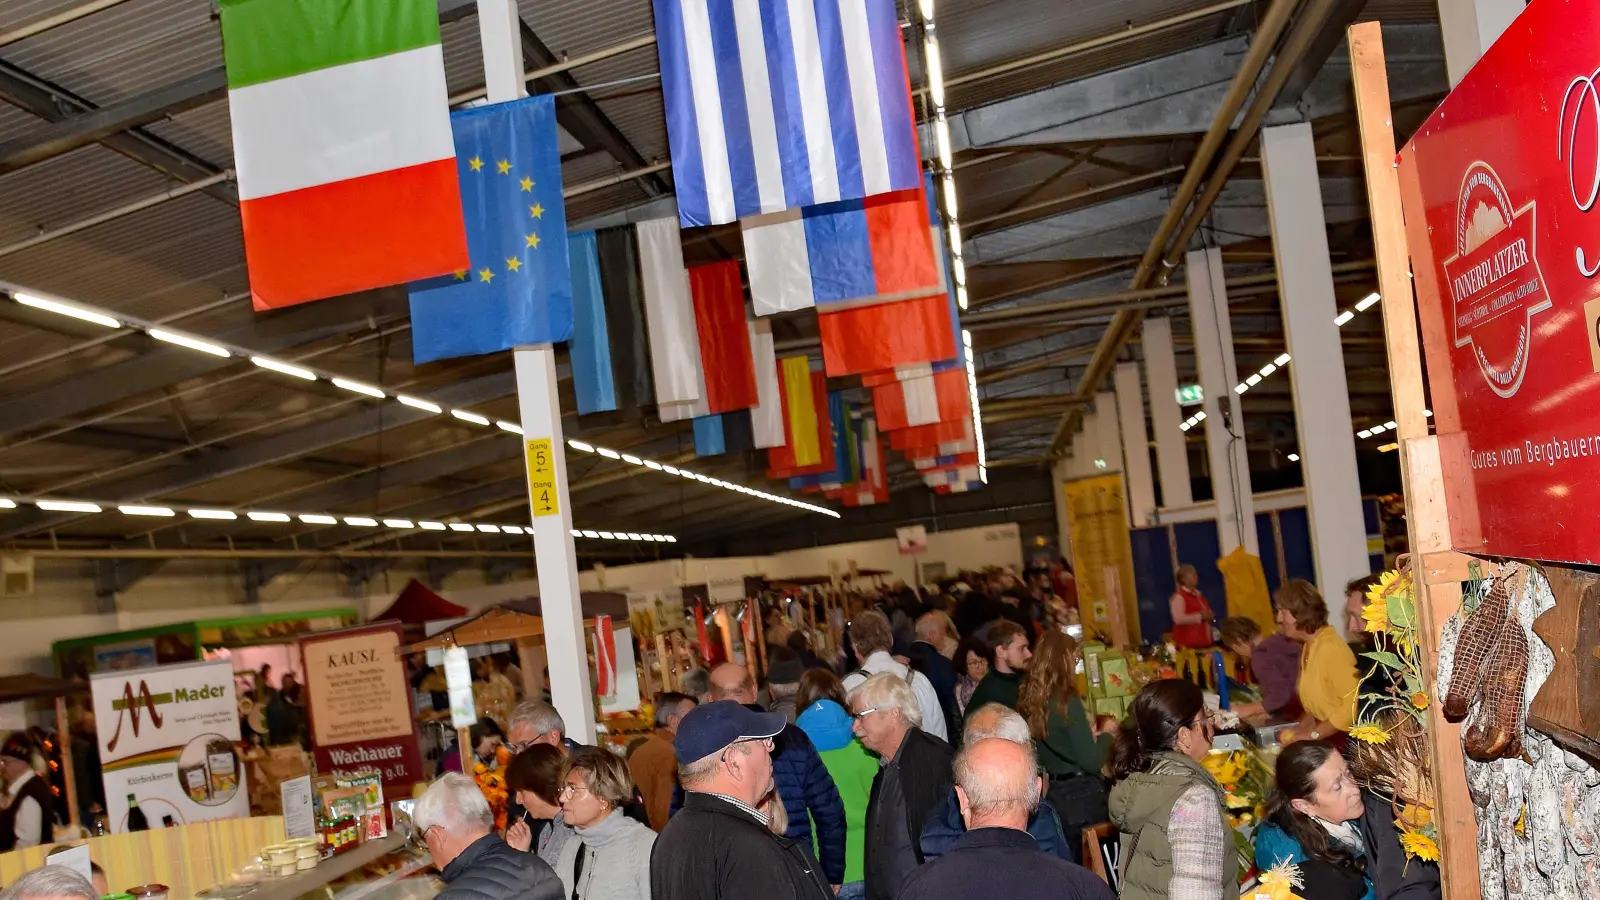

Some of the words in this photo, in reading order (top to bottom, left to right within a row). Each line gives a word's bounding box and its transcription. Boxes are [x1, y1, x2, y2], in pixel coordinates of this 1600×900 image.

[1454, 238, 1529, 303] INNERPLATZER
[536, 451, 546, 466] 5
[1470, 449, 1498, 470] Gutes
[1500, 446, 1523, 466] vom
[533, 481, 552, 489] Gang
[540, 489, 550, 504] 4
[327, 648, 380, 668] KAUSL
[174, 684, 226, 703] Mader
[329, 745, 403, 766] Wachauer
[385, 764, 409, 781] g.U.
